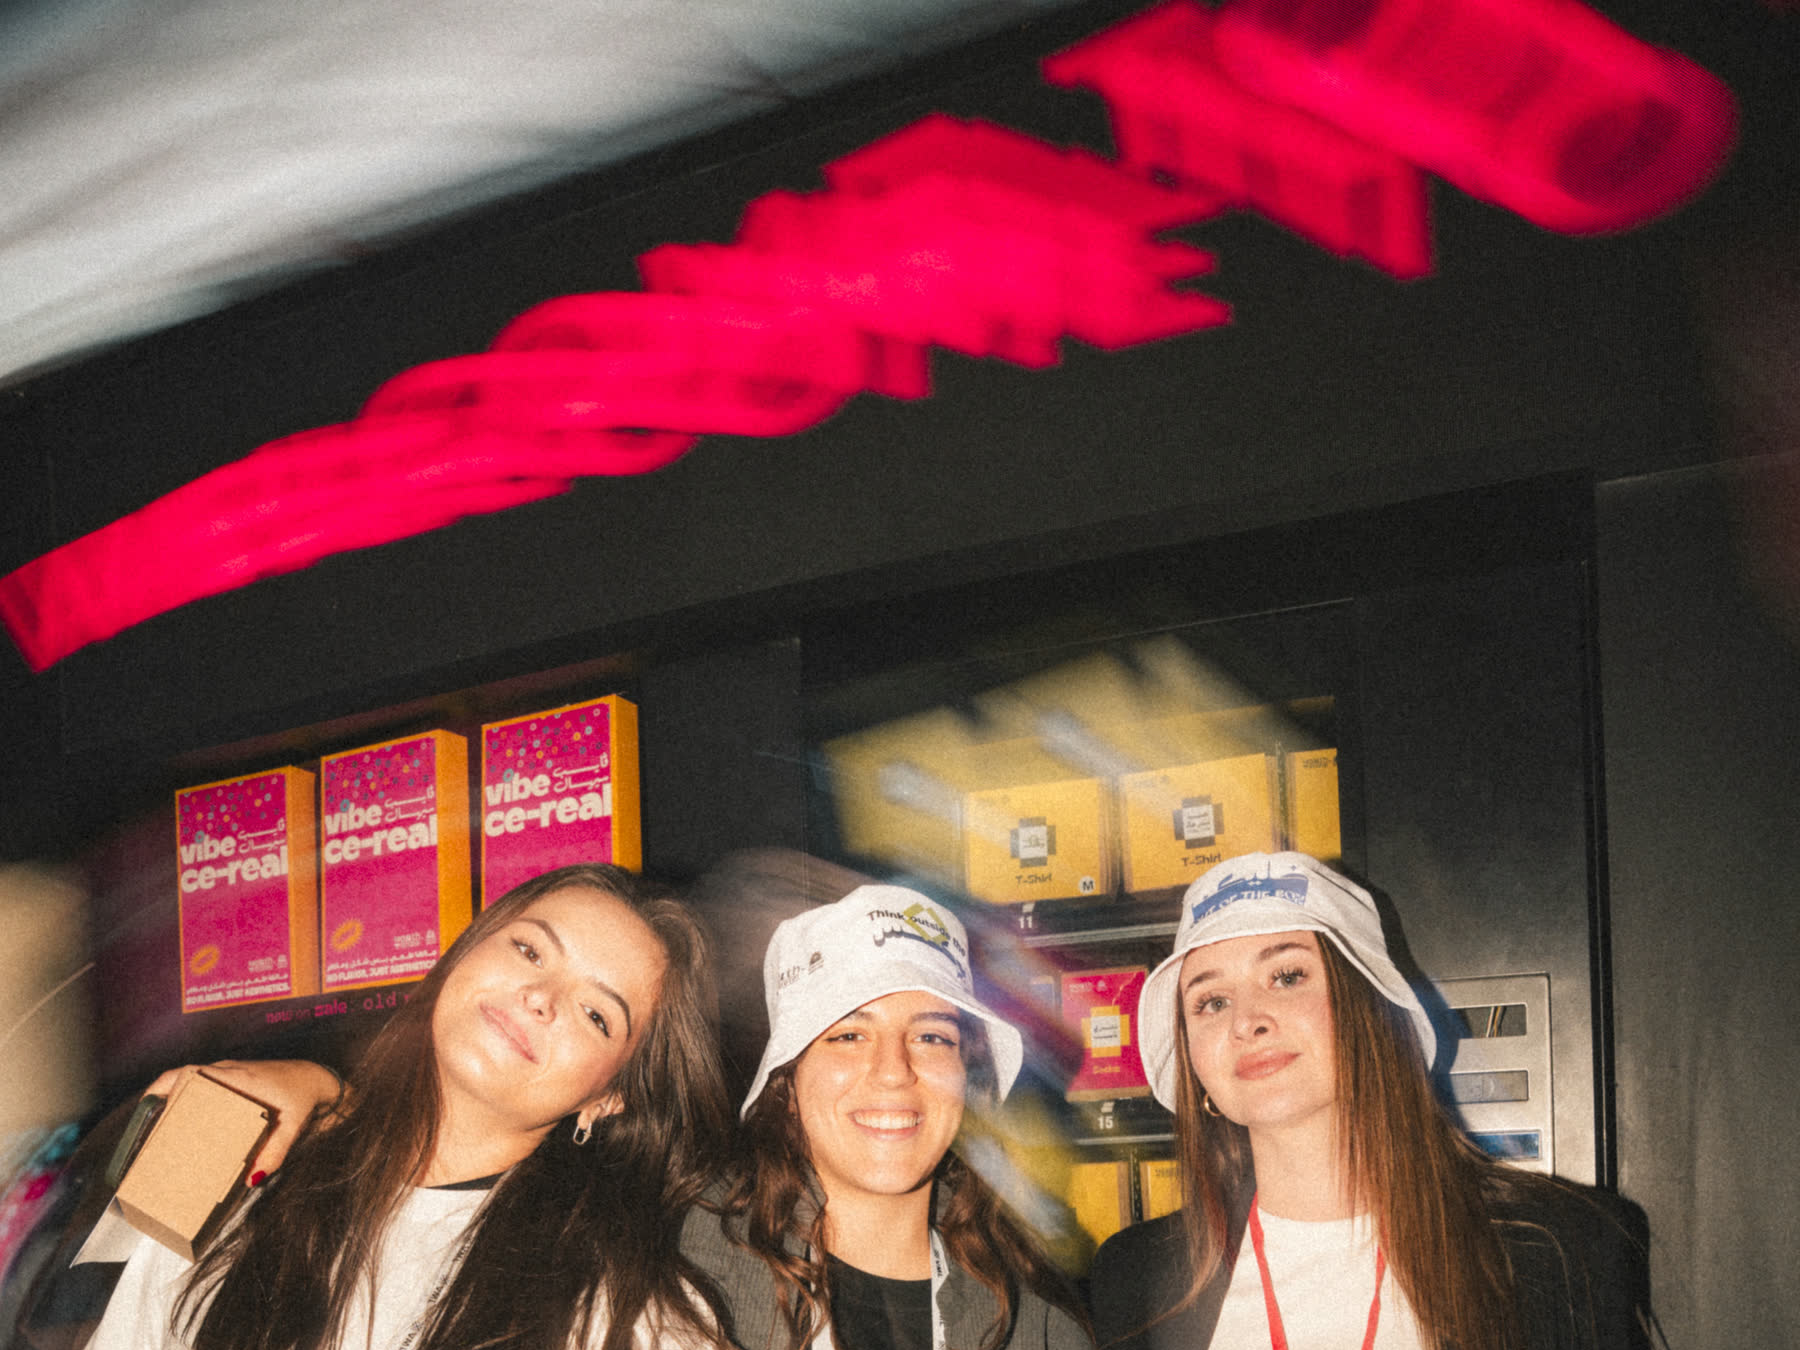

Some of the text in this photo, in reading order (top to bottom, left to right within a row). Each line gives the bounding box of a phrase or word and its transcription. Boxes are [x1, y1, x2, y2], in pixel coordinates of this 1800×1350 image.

[485, 768, 551, 806] vibe
[325, 799, 382, 835] vibe
[485, 783, 612, 837] ce-real
[180, 830, 237, 865] vibe
[325, 814, 438, 864] ce-real
[181, 846, 288, 893] ce-real
[1182, 853, 1222, 866] T-Shirt
[1082, 880, 1094, 891] M
[1241, 890, 1270, 900] THE
[867, 909, 905, 921] Think
[953, 937, 966, 957] the
[1018, 917, 1033, 929] 11
[266, 1009, 292, 1024] now
[363, 992, 396, 1011] old
[1097, 1116, 1113, 1129] 15
